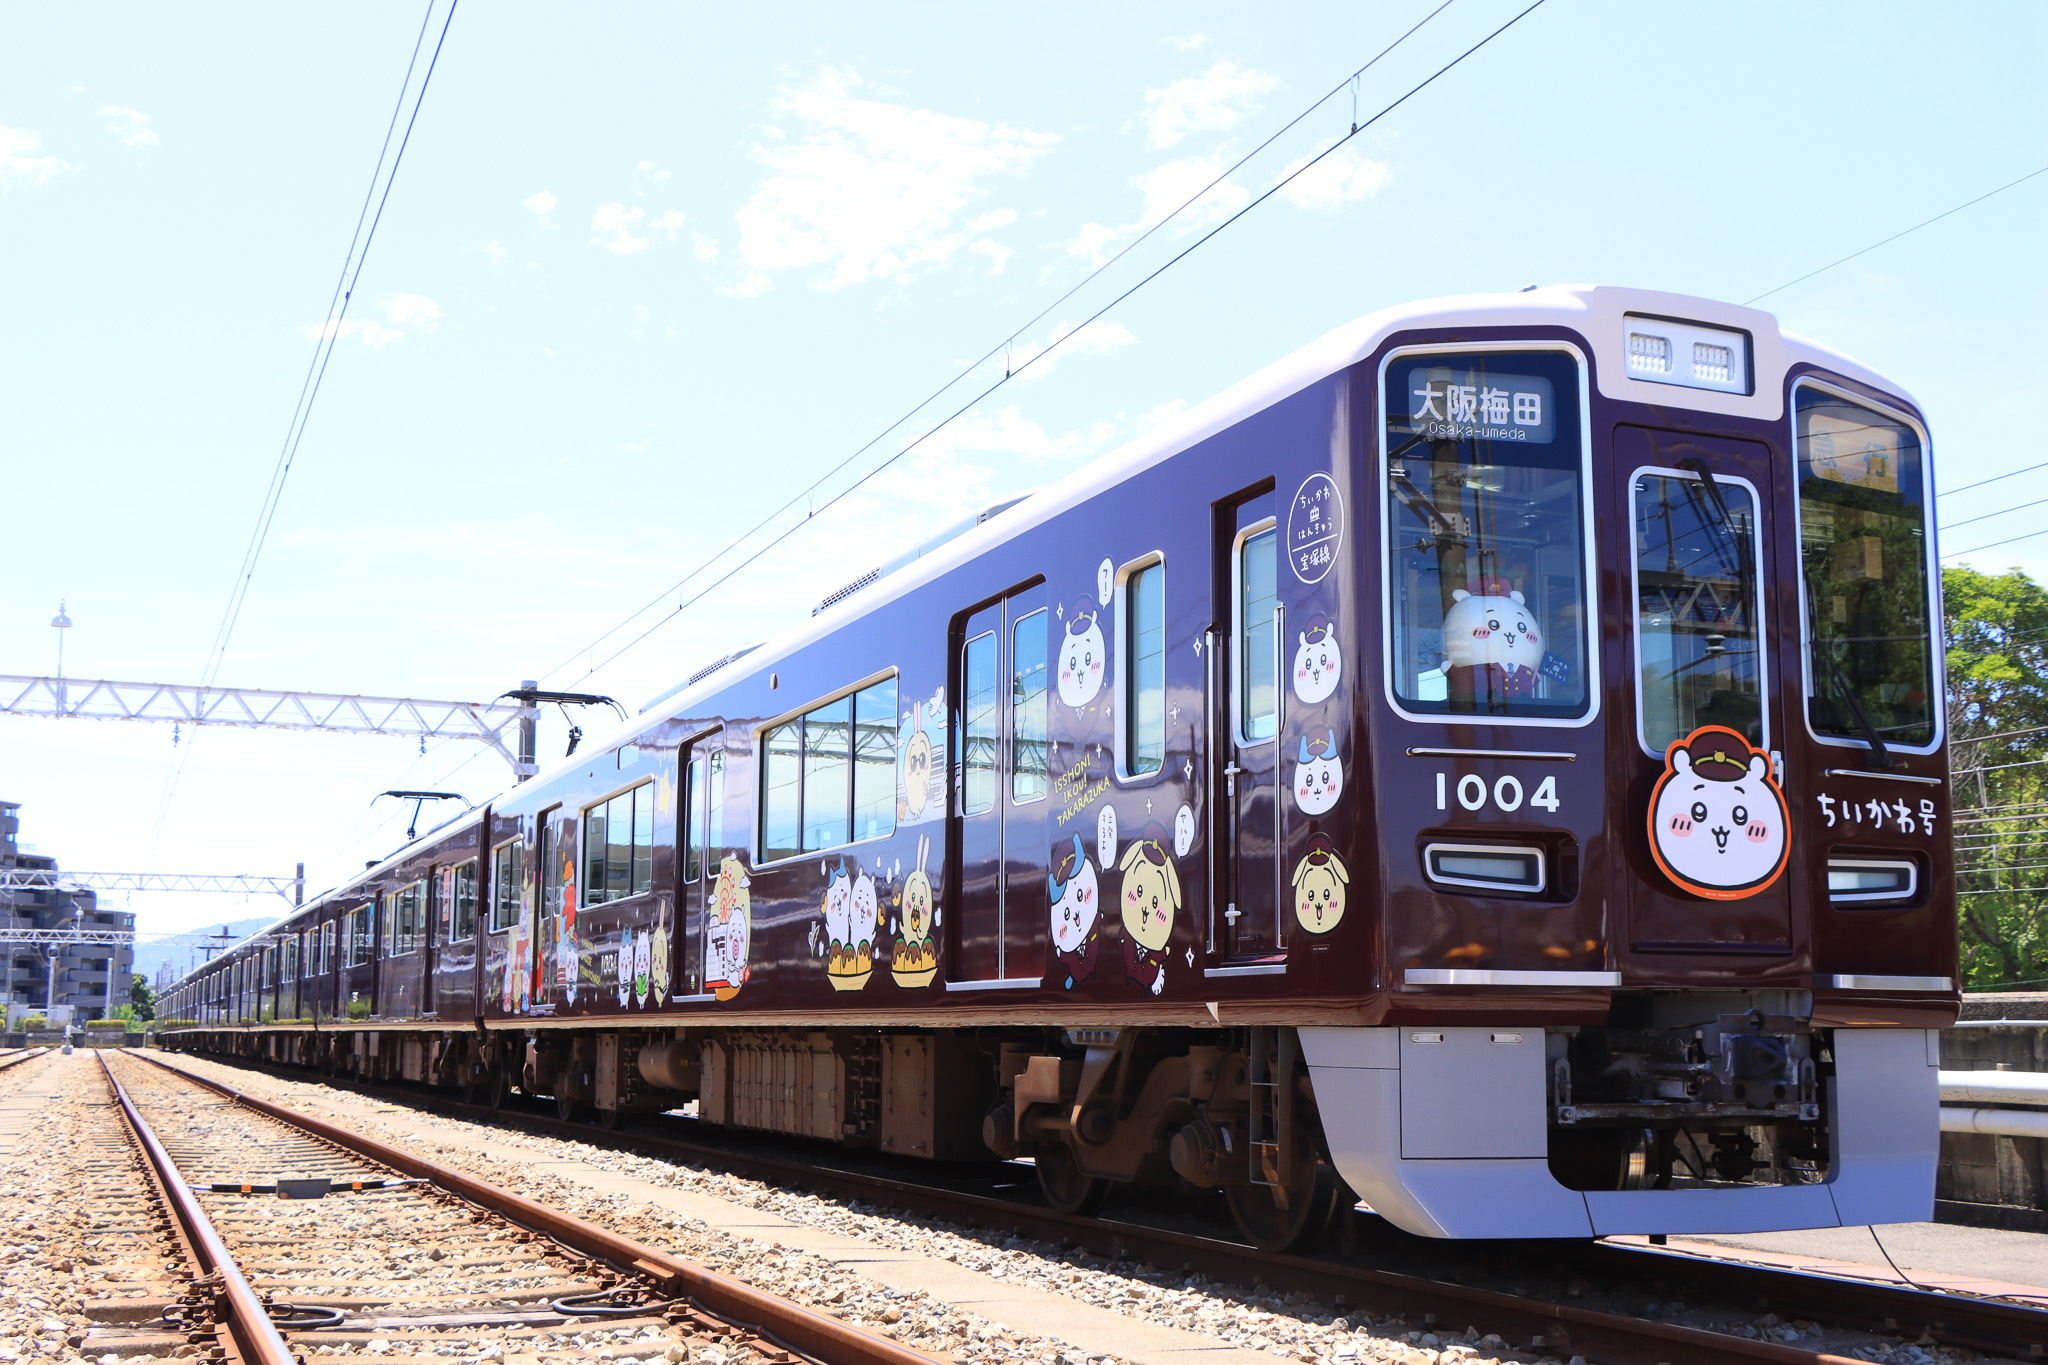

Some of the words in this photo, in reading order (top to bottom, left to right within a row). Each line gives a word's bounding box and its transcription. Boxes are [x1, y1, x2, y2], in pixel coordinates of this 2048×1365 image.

[1413, 382, 1541, 426] 大阪梅田
[1429, 422, 1526, 440] Osaka-umeda
[1812, 430, 1888, 477] 急行
[1300, 485, 1330, 509] ちいかわ
[1298, 516, 1332, 540] はんきゅう
[1300, 544, 1331, 572] 宝塚線
[1054, 753, 1091, 794] ISSHONI
[1063, 773, 1087, 803] IKOU!
[1436, 772, 1560, 813] 1004
[1057, 776, 1110, 827] TAKARAZUKA
[1817, 793, 1937, 836] ちいかわ号
